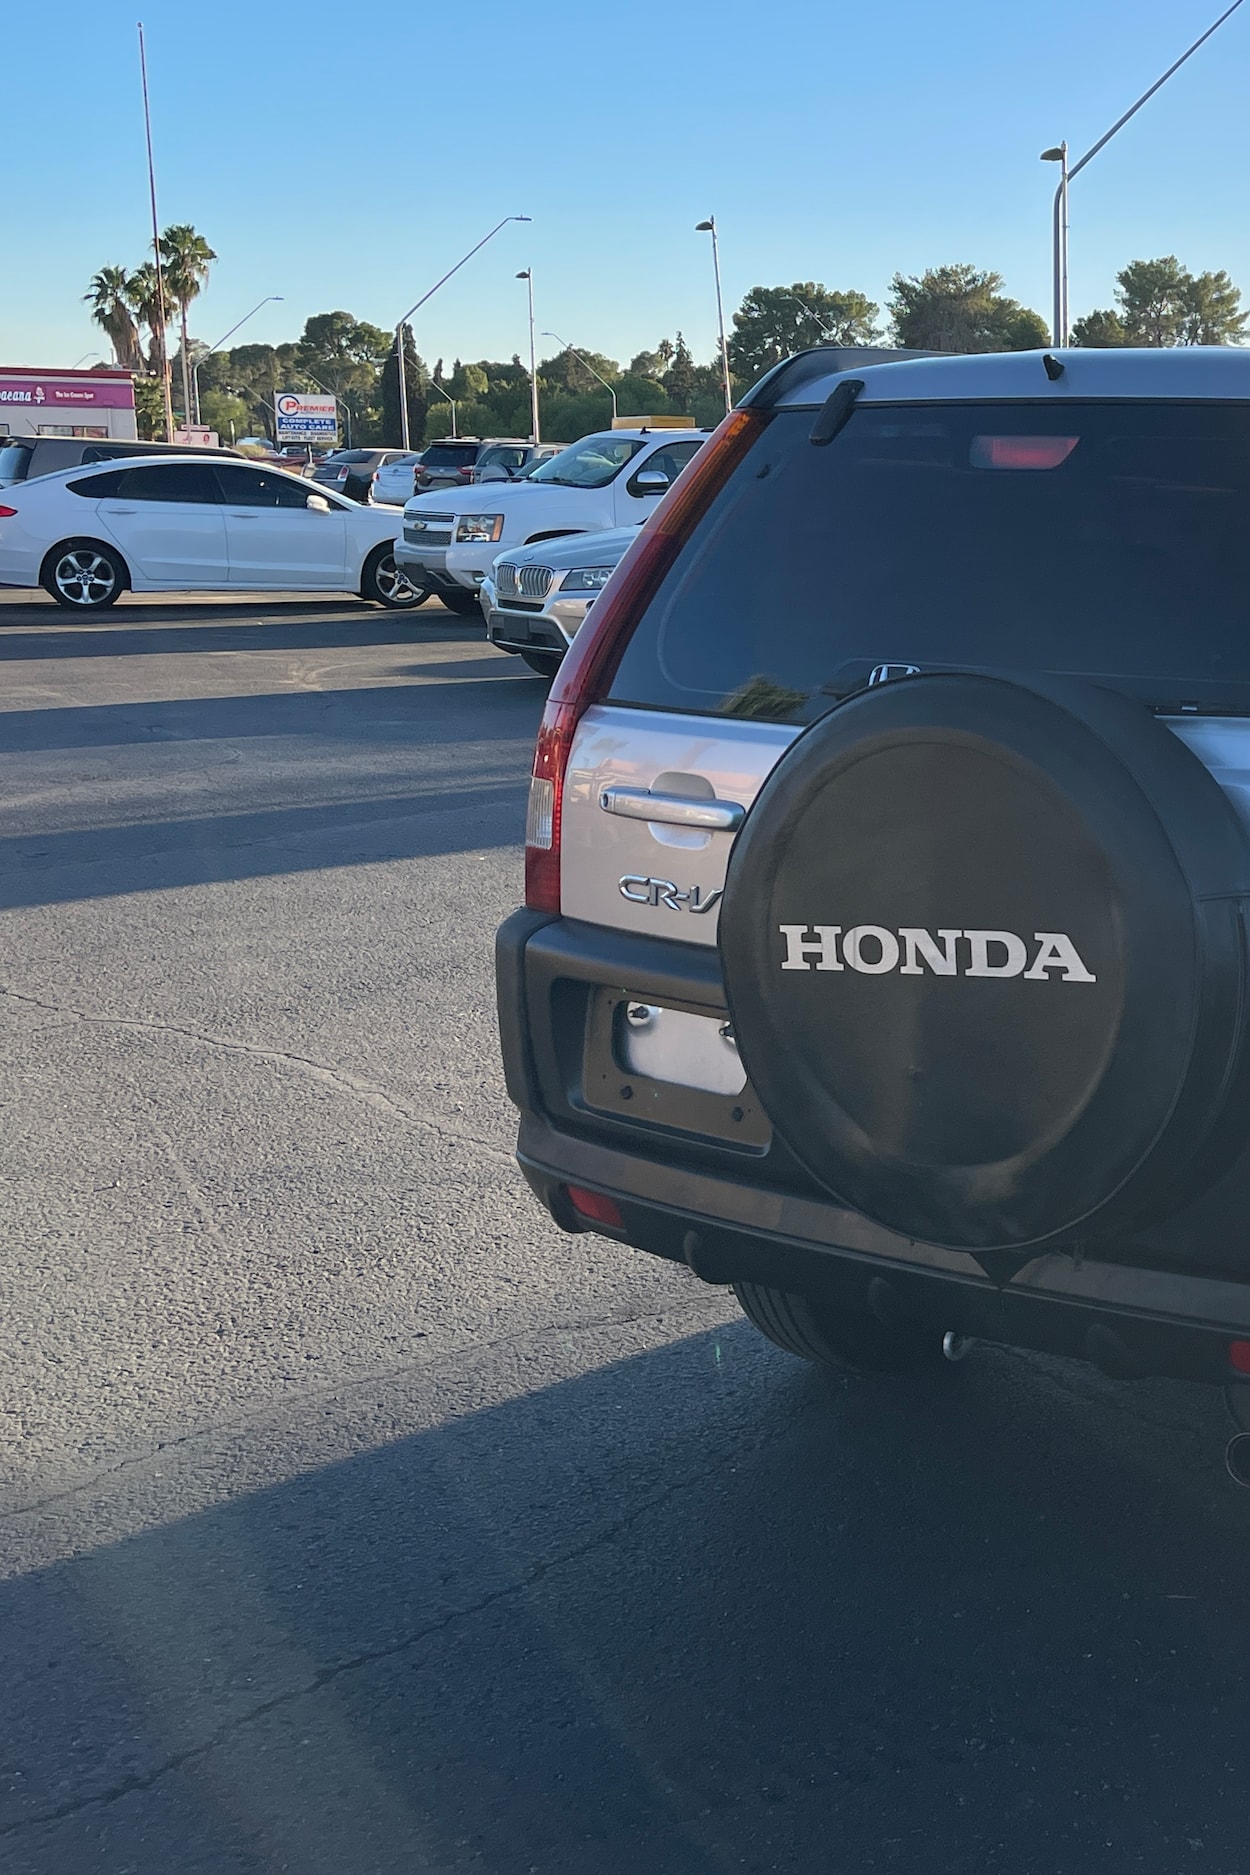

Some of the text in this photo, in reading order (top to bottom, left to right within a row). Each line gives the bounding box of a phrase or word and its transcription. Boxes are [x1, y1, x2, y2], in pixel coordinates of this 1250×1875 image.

[286, 401, 335, 412] PREMIER
[619, 874, 724, 914] CR-V
[779, 924, 1097, 983] HONDA
